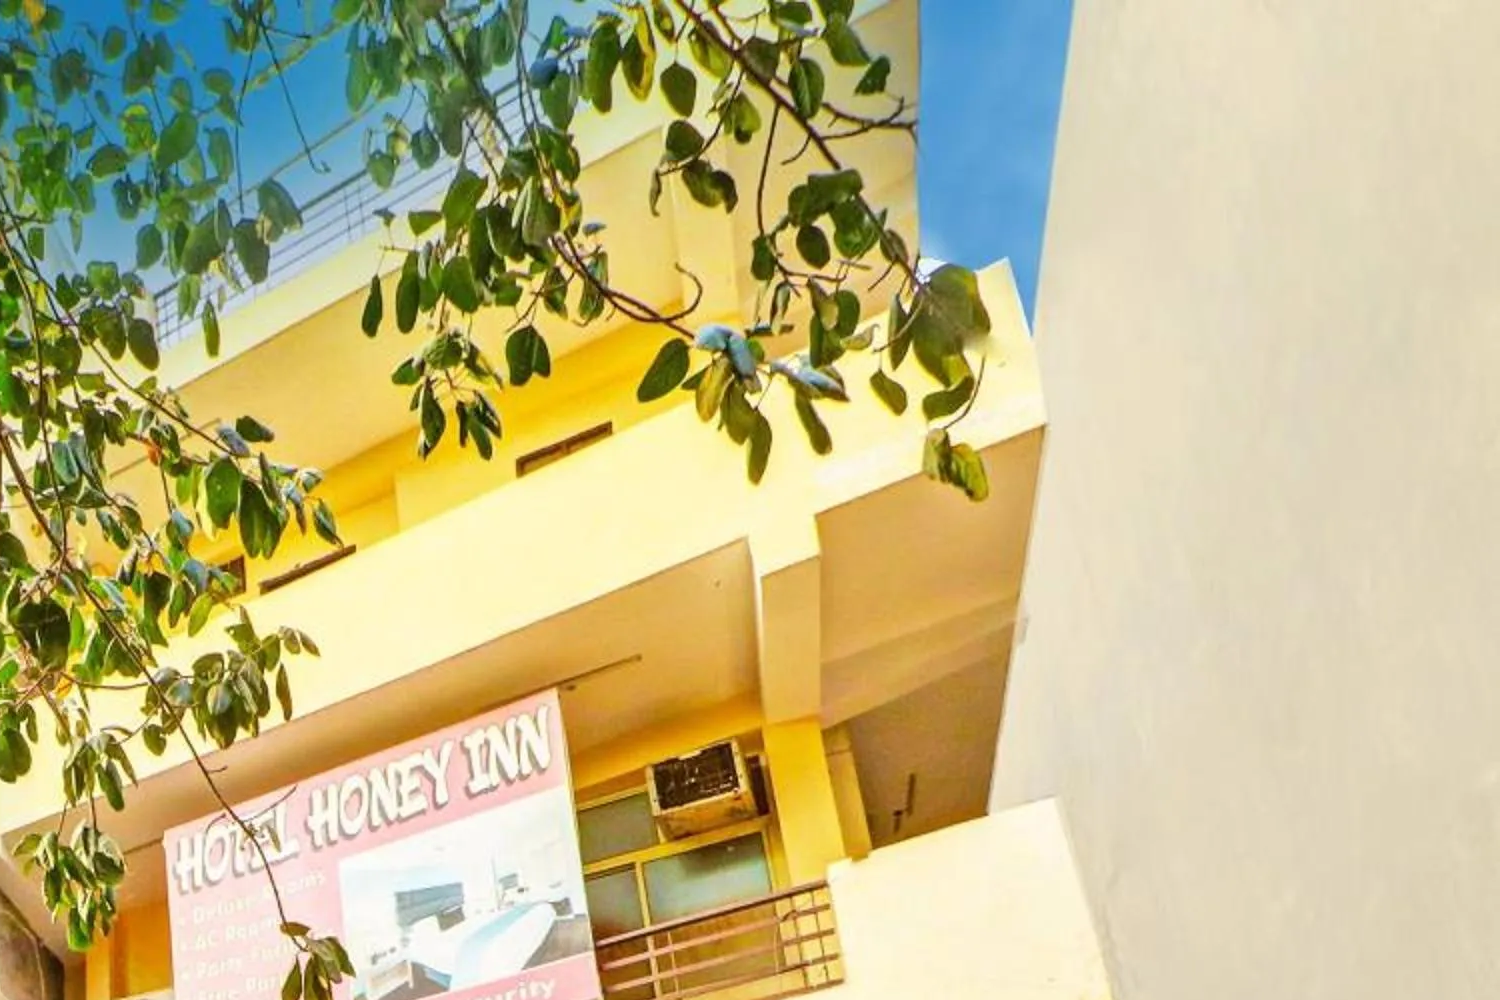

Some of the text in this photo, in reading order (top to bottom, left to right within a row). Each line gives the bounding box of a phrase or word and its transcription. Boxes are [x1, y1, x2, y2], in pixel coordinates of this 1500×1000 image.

[173, 704, 552, 895] HOTEL HONEY INN
